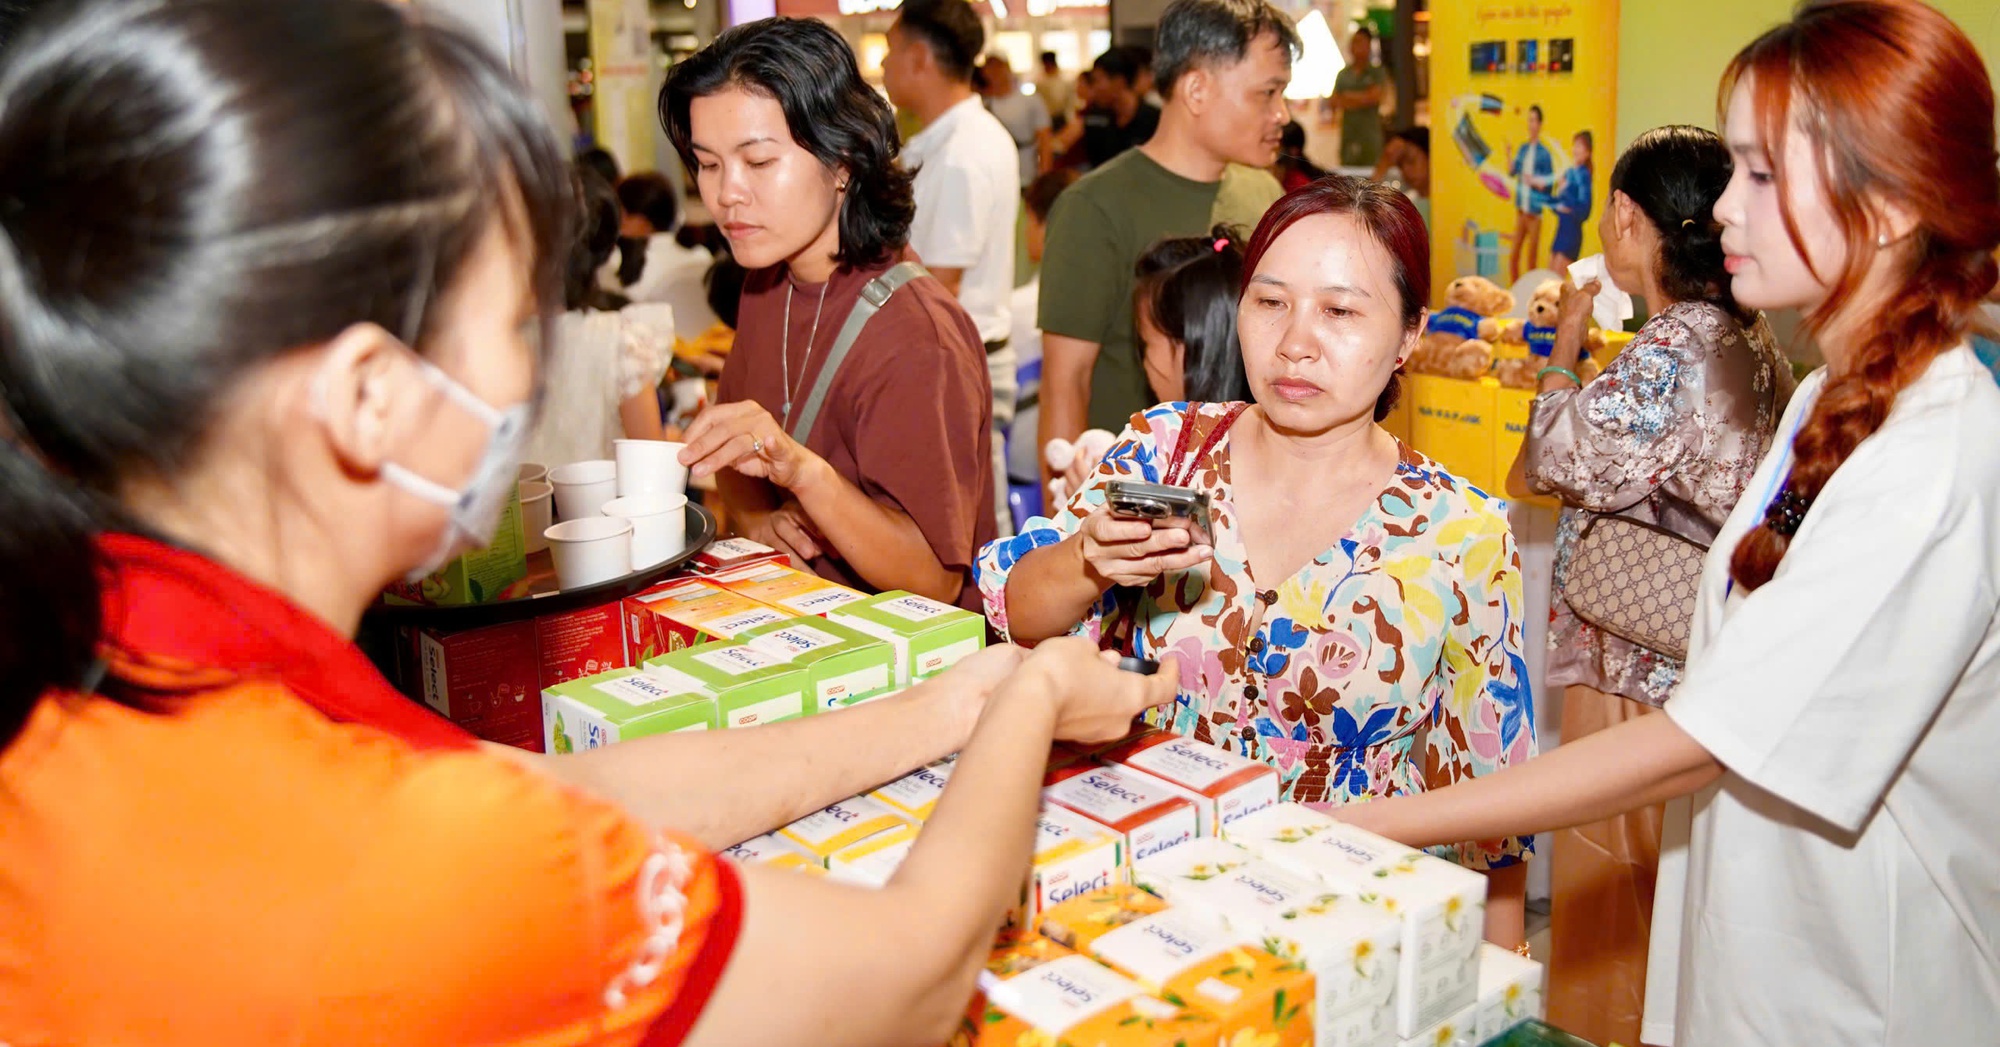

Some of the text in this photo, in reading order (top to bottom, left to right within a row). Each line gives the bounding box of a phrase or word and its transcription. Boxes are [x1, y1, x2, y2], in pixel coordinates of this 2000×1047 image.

[797, 592, 851, 608] Select
[898, 598, 941, 614] Select
[719, 613, 776, 630] Select
[624, 677, 668, 696] Select
[1165, 743, 1229, 770] Select
[1081, 775, 1146, 804] Select
[1322, 837, 1373, 862] Select
[1234, 875, 1285, 902] Select
[1143, 924, 1193, 954] Select
[1042, 971, 1092, 1003] Select
